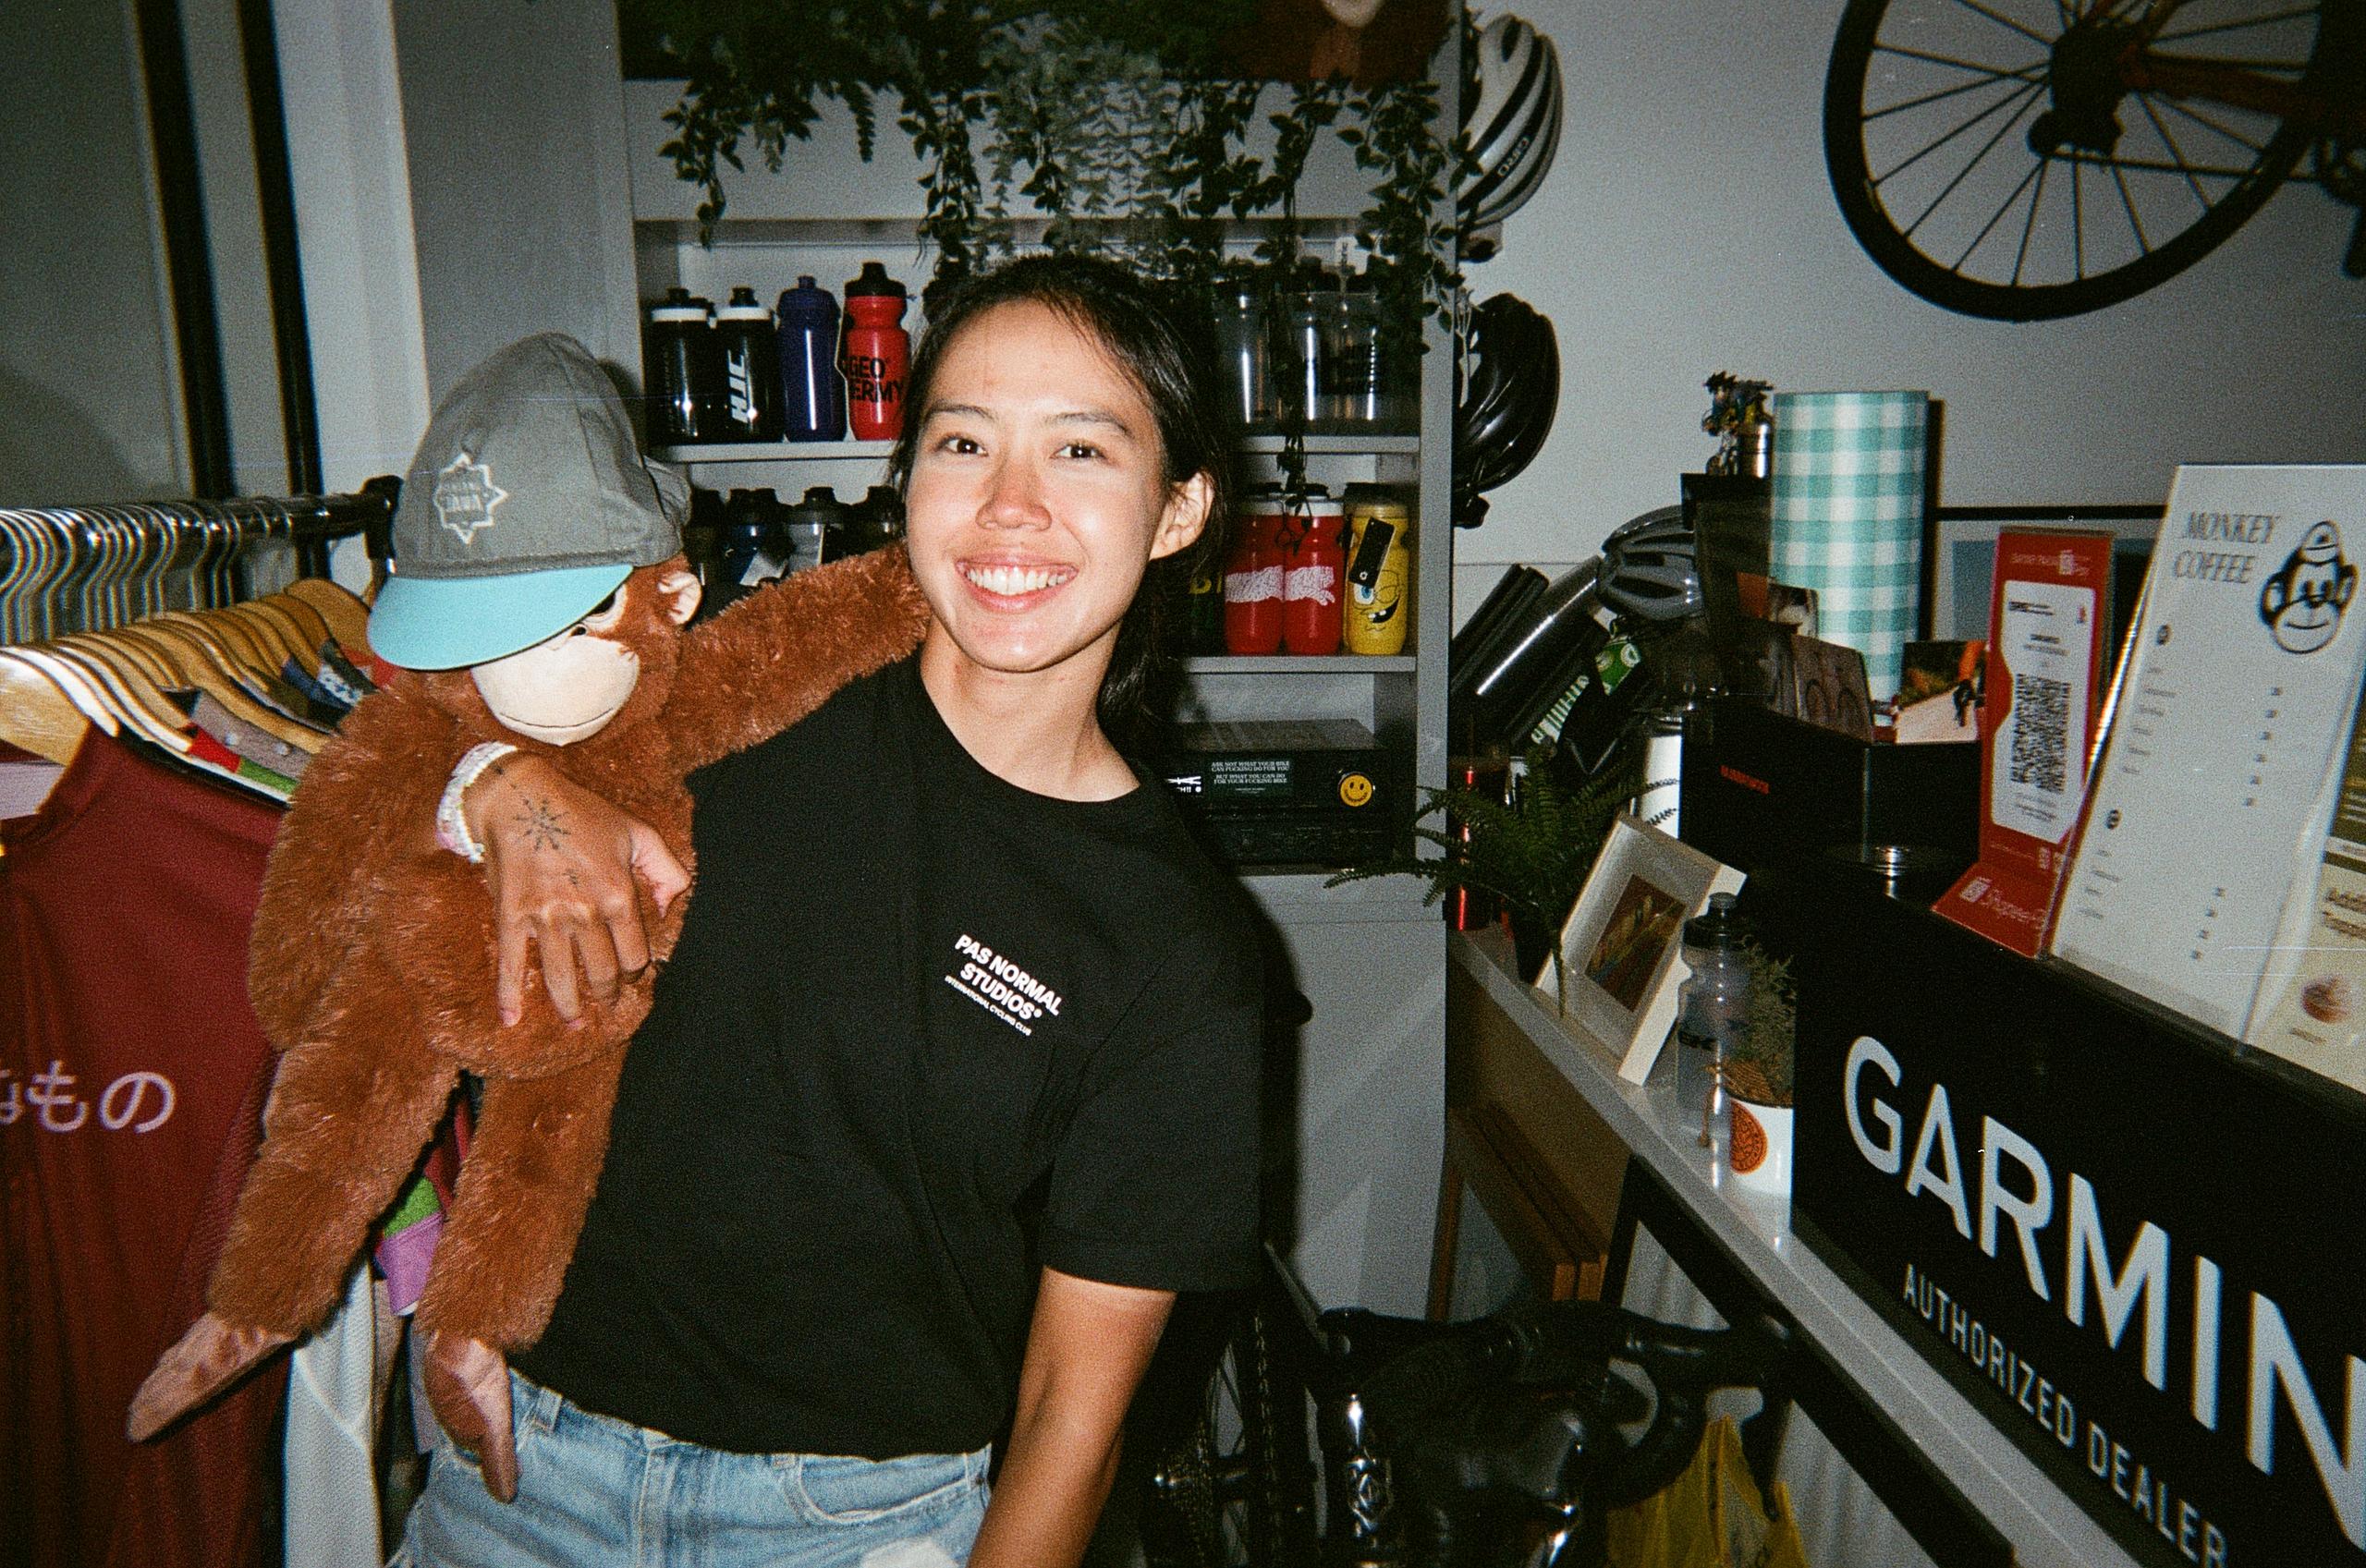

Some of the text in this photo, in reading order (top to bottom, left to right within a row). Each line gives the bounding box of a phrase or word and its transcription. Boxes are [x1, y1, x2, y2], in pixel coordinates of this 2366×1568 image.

[728, 349, 749, 423] HJC
[842, 356, 886, 380] GEO
[2182, 511, 2280, 544] MONKEY
[2174, 551, 2255, 584] COFFEE
[955, 934, 1062, 1015] PAS NORMAL
[989, 1003, 1017, 1027] CYCLING
[1015, 1021, 1032, 1036] CLUB
[1844, 1035, 2366, 1553] GARMIN
[1902, 1262, 2229, 1568] AUTHORIZED DEALER
